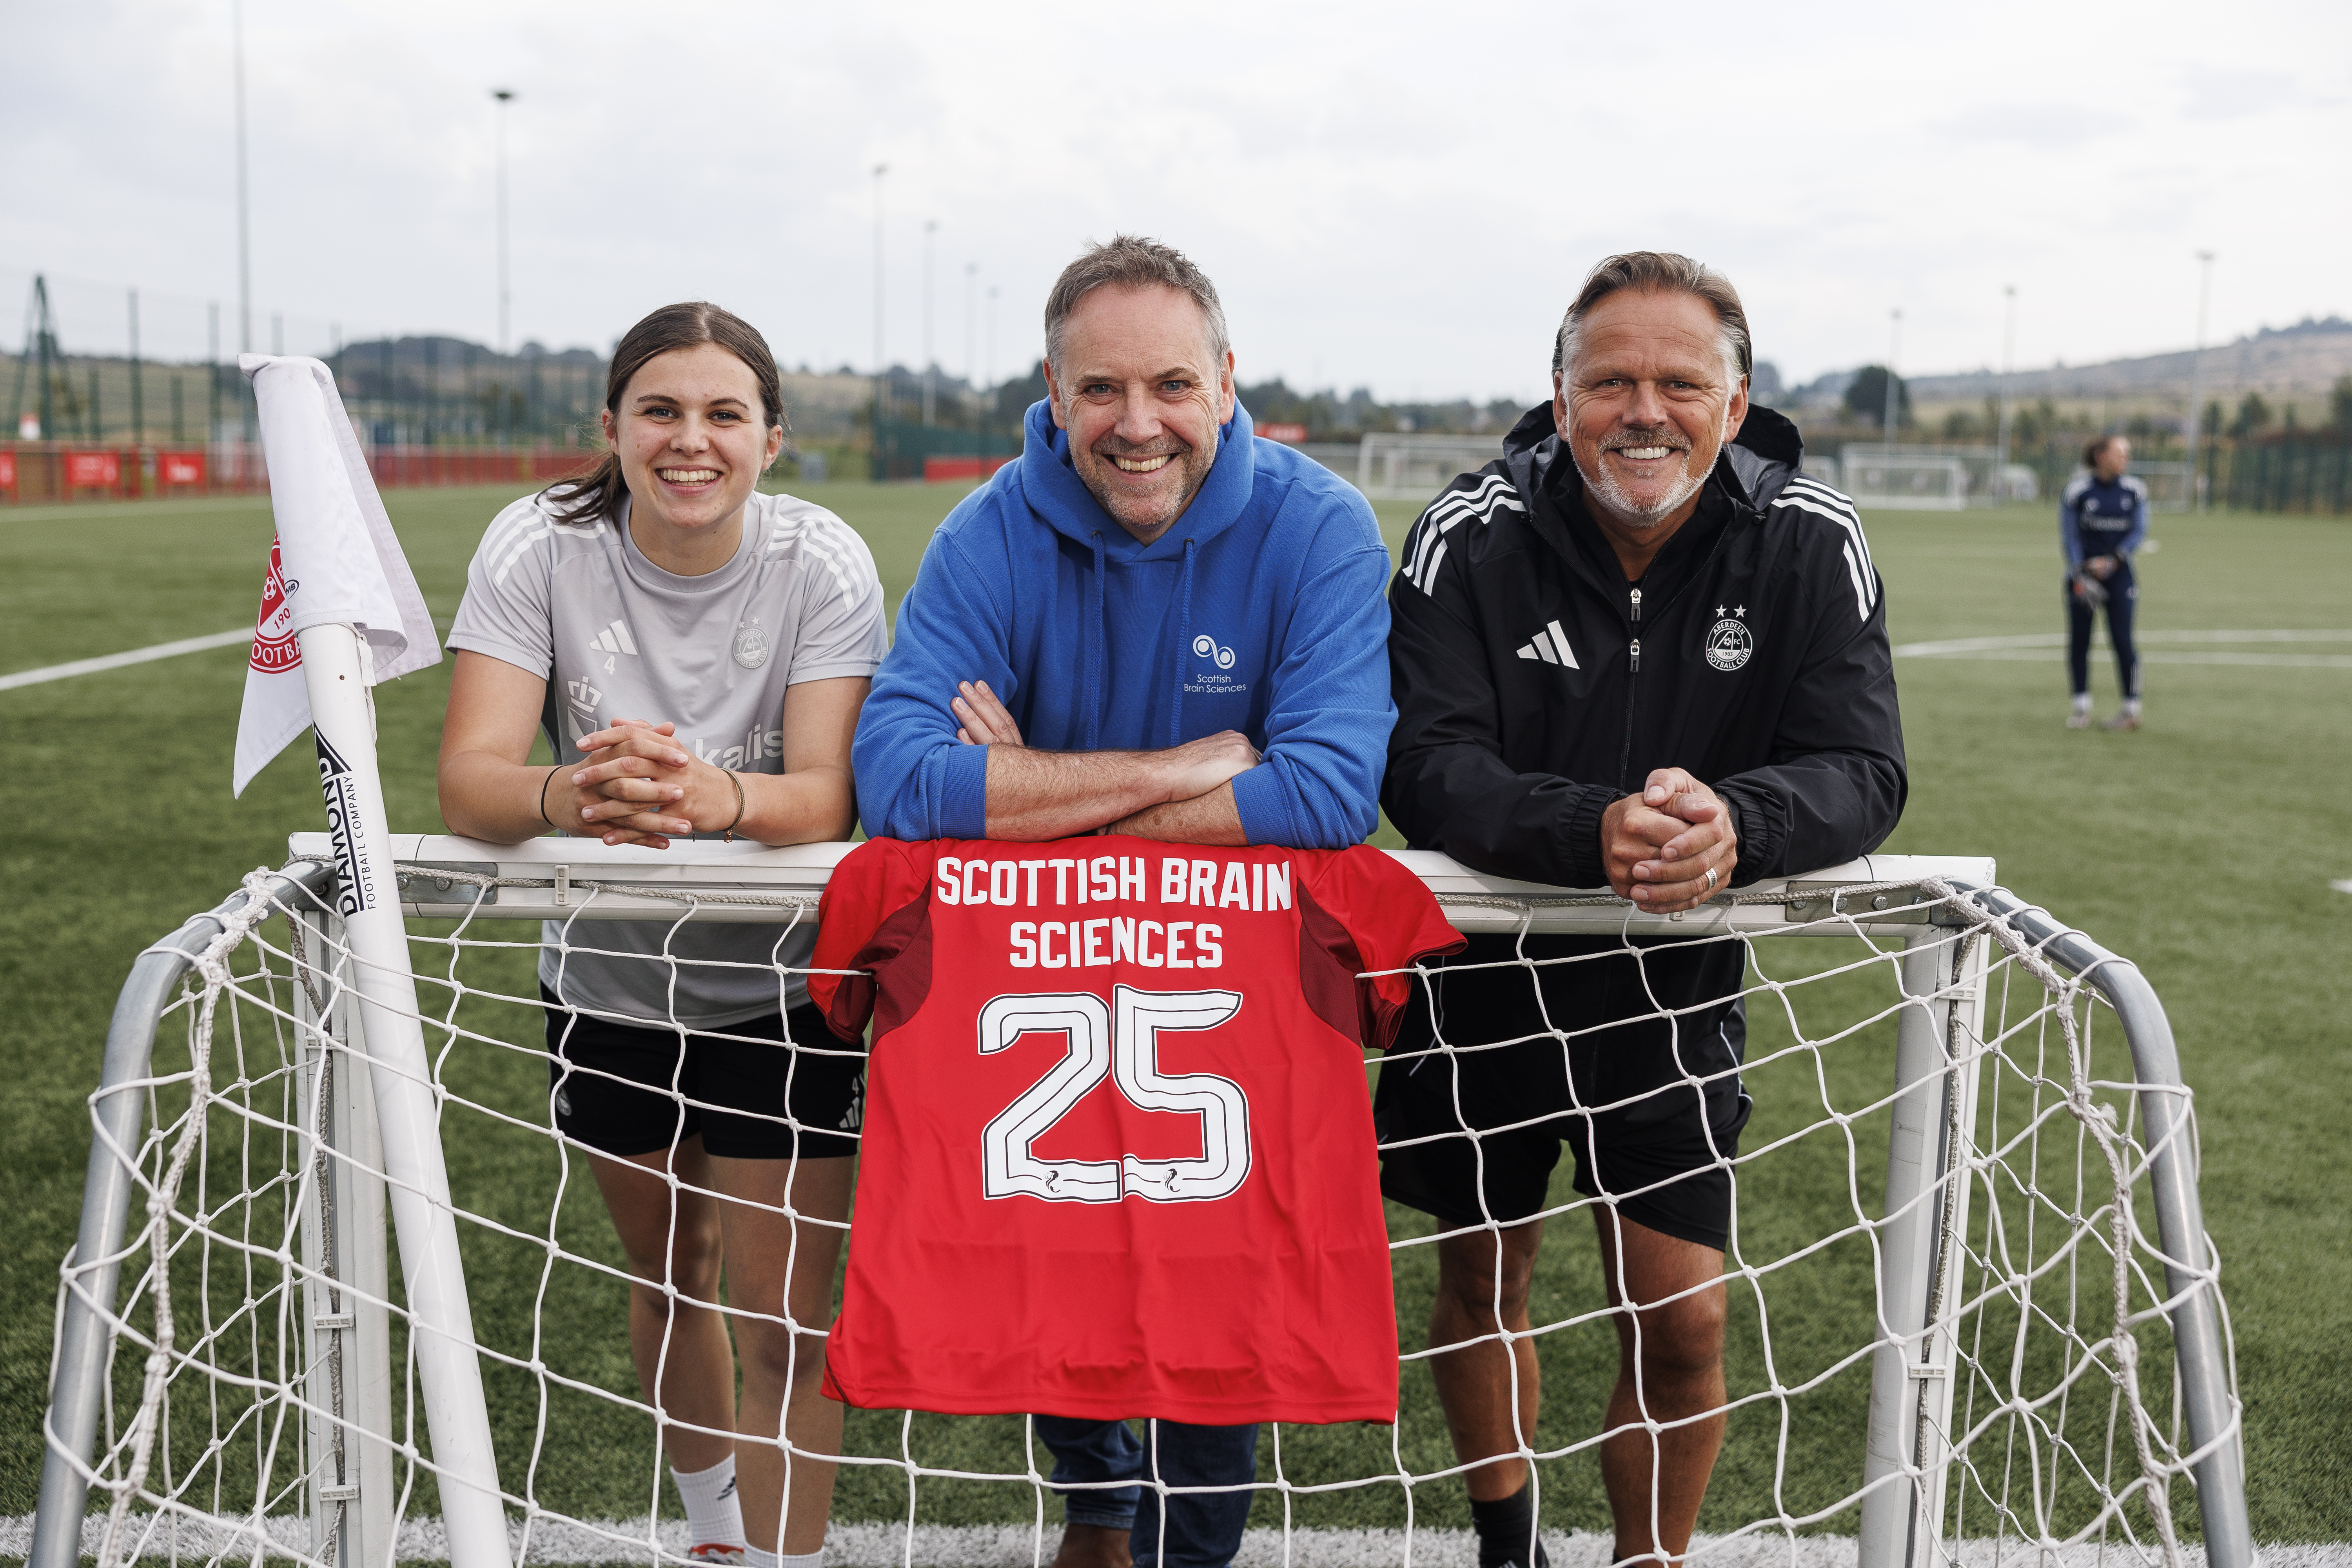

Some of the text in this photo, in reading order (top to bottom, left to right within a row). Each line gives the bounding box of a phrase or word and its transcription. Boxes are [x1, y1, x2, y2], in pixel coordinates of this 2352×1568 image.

[286, 583, 296, 595] MS
[274, 605, 290, 630] 190
[737, 630, 762, 642] ABERDEEN
[1713, 622, 1746, 635] ABERDEEN
[252, 637, 300, 664] OOTBA
[736, 653, 760, 666] FOOTBALL
[1707, 648, 1749, 669] FOOTBALL CLUB
[604, 655, 615, 675] 4
[1184, 684, 1246, 693] Brain Sciences
[1197, 674, 1231, 683] Scottish
[319, 758, 358, 918] DIAMOND
[343, 777, 376, 909] FOOTBALL COMPANY
[937, 856, 1292, 912] SCOTTISH BRAIN
[1010, 916, 1222, 969] SCIENCES
[852, 1077, 859, 1094] 4
[977, 984, 1252, 1204] 25
